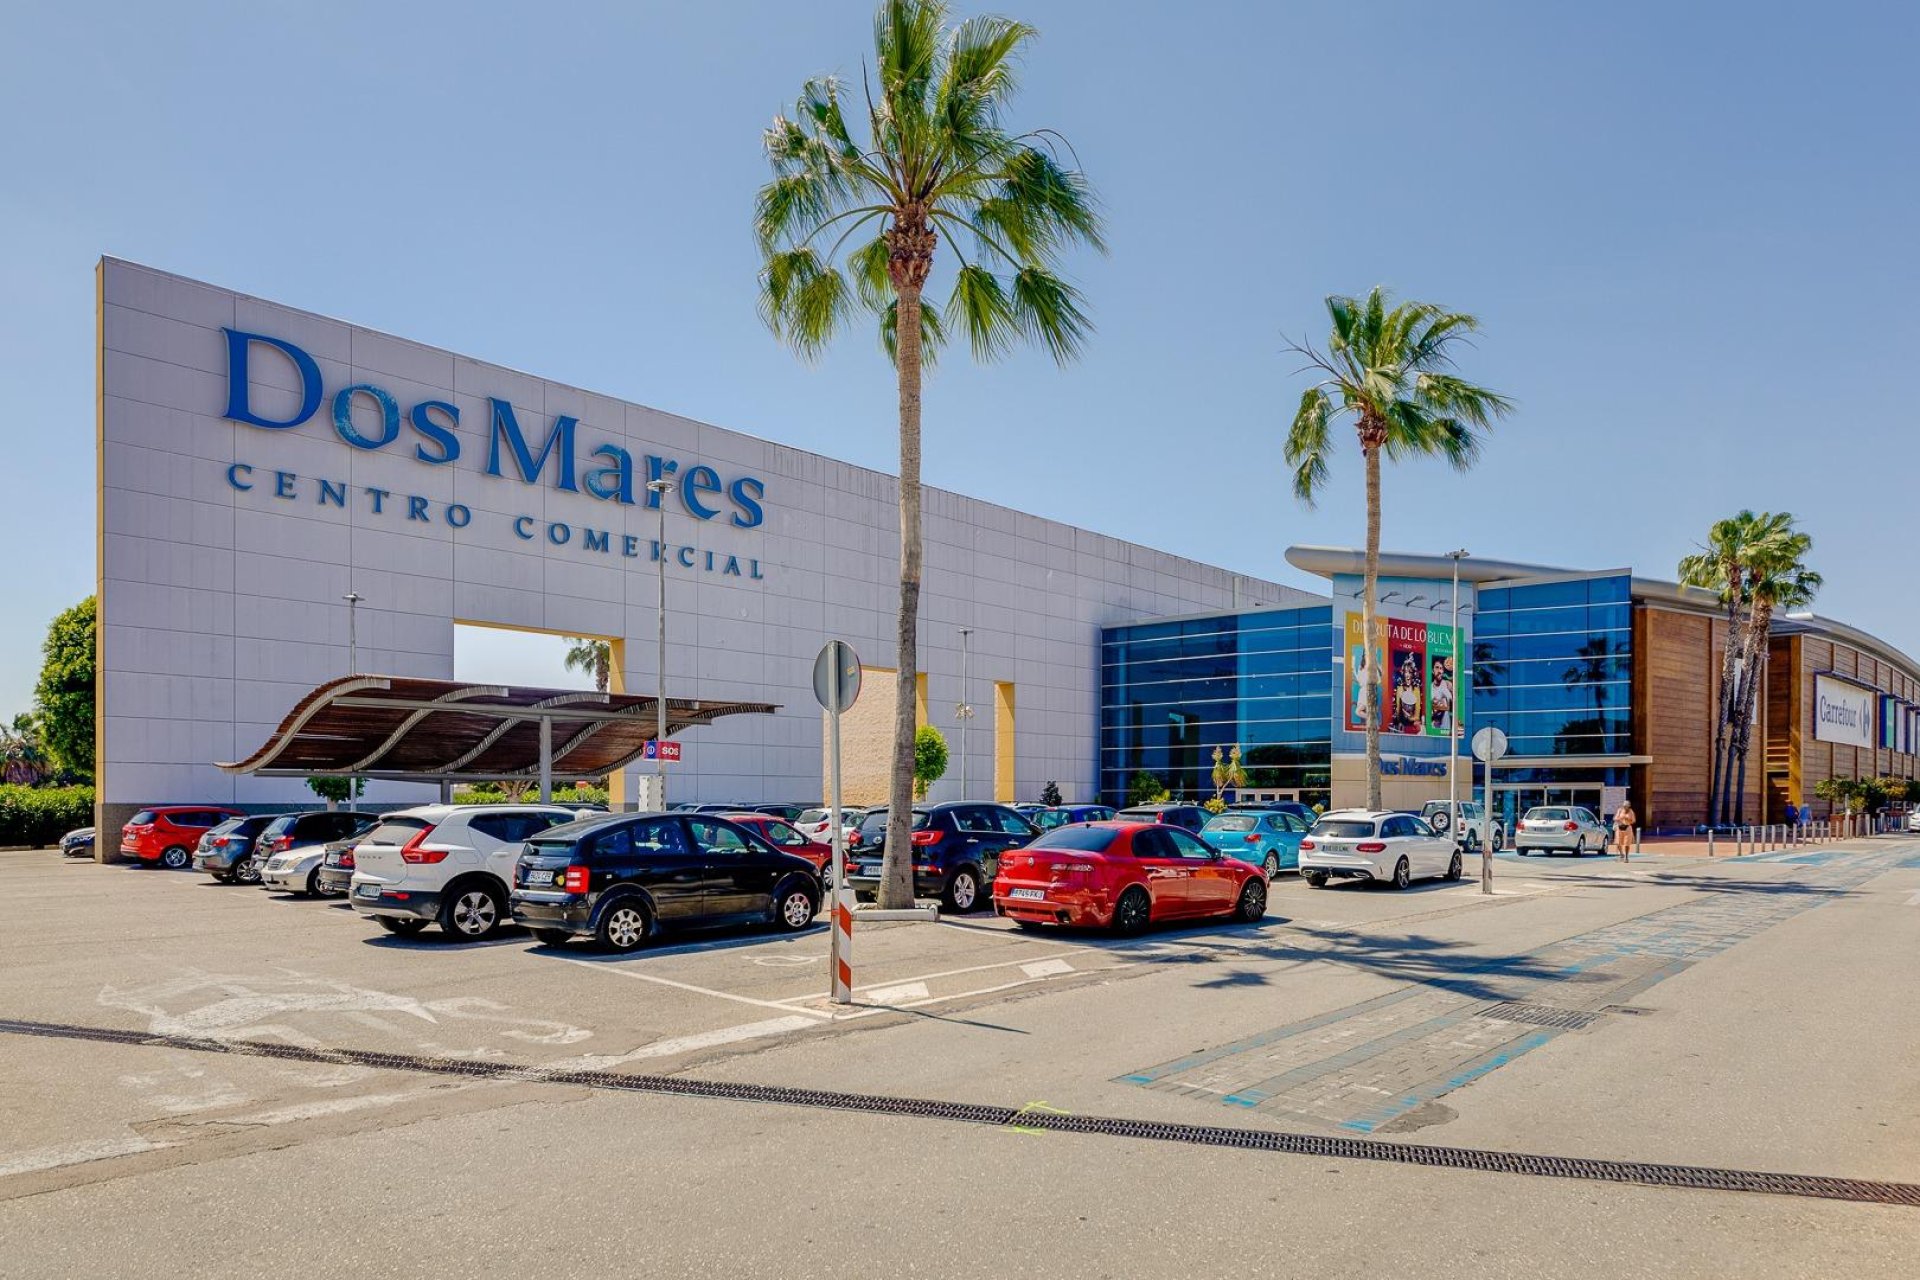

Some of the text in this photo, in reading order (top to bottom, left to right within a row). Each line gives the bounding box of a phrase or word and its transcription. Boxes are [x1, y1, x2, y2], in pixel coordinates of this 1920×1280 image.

[220, 327, 765, 530] Dos Mares
[228, 463, 764, 580] CENTRO COMERCIAL
[1820, 695, 1857, 728] Carrefour
[661, 746, 680, 756] SOS
[1401, 757, 1447, 776] Mares
